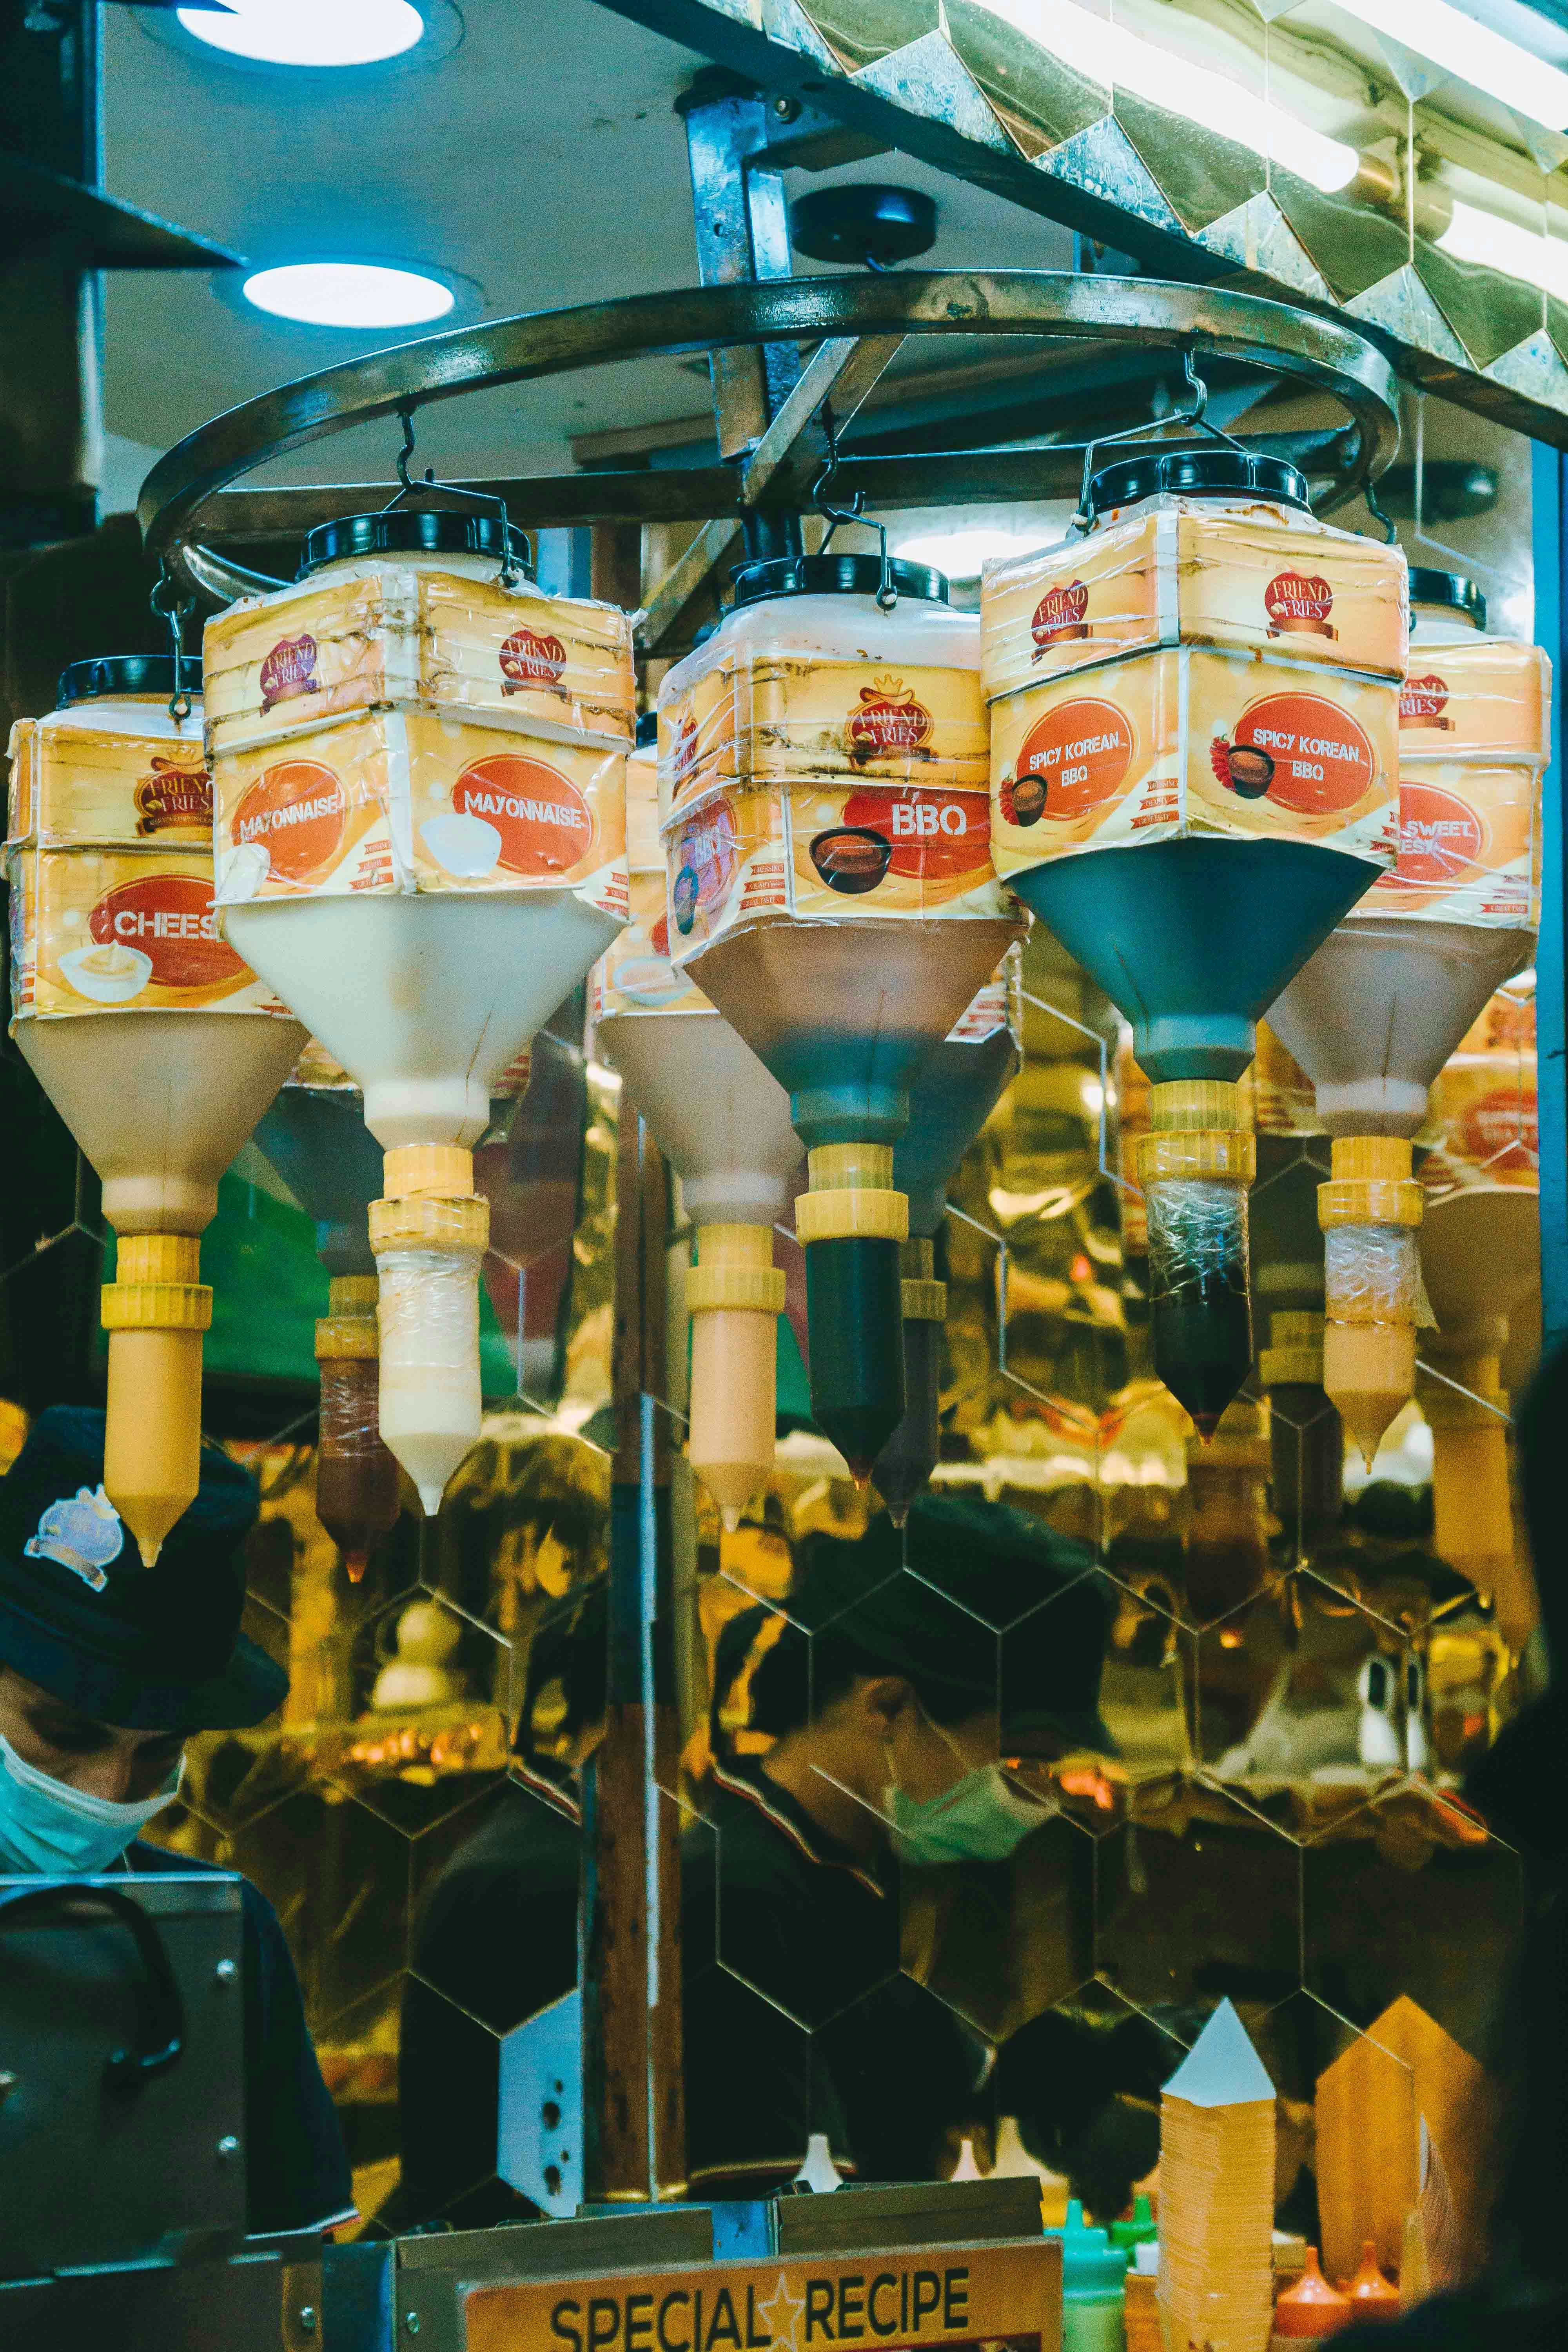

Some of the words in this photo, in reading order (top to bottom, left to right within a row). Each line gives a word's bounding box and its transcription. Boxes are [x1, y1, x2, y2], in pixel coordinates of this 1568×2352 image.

[1273, 581, 1329, 602] FRIEND
[1038, 589, 1085, 622] FRIEND
[1283, 600, 1323, 618] FRIES
[860, 709, 926, 728] FRIEND
[870, 726, 918, 744] FRIES
[1253, 728, 1296, 750] SPICY
[1299, 736, 1359, 762] KOREAN
[1029, 746, 1062, 771] SPICY
[1065, 730, 1119, 760] KOREAN
[1061, 765, 1088, 787] BBQ
[1292, 760, 1323, 780] BBQ
[160, 795, 210, 813] FRIES
[240, 793, 338, 837] MAYONNAISE
[464, 790, 582, 828] MAYONNAISE
[893, 804, 967, 835] BBQ
[1406, 820, 1471, 836] SWEET
[114, 911, 217, 940] CHEES
[551, 2284, 771, 2352] SPECIAL
[806, 2268, 969, 2342] RECIPE
